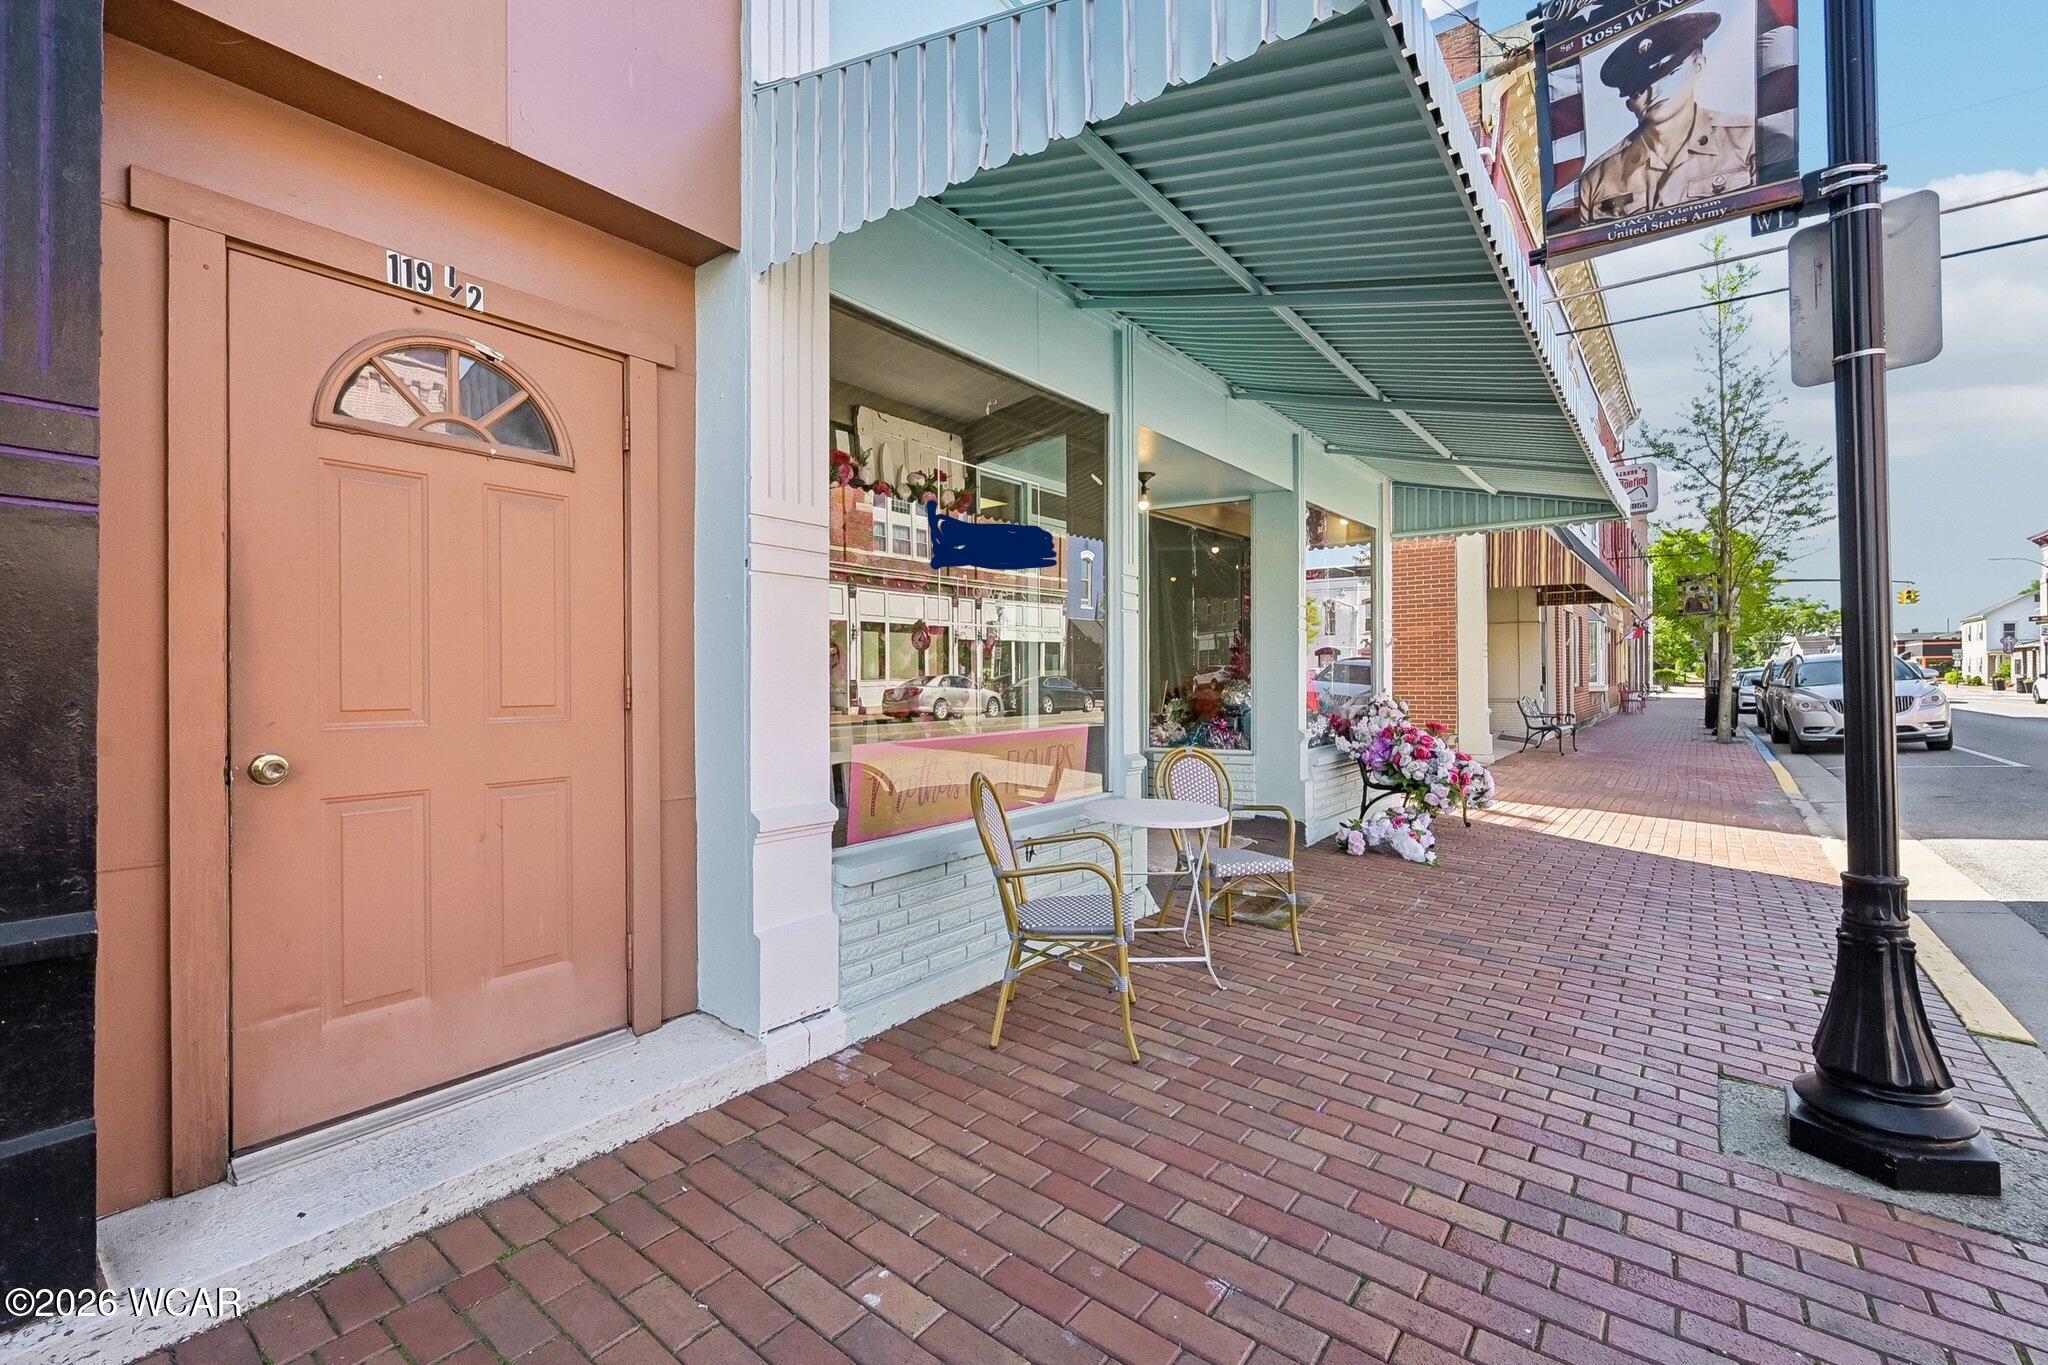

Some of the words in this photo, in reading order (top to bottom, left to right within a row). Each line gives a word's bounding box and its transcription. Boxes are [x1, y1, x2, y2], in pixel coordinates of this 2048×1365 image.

[1560, 42, 1574, 52] Sgt
[1581, 21, 1622, 49] Ross
[1626, 6, 1651, 26] W.
[1607, 226, 1648, 241] United
[1651, 217, 1688, 230] States
[1691, 205, 1729, 222] Army
[1614, 213, 1656, 230] MACV
[1667, 199, 1723, 215] Vietnam
[387, 252, 432, 293] 119
